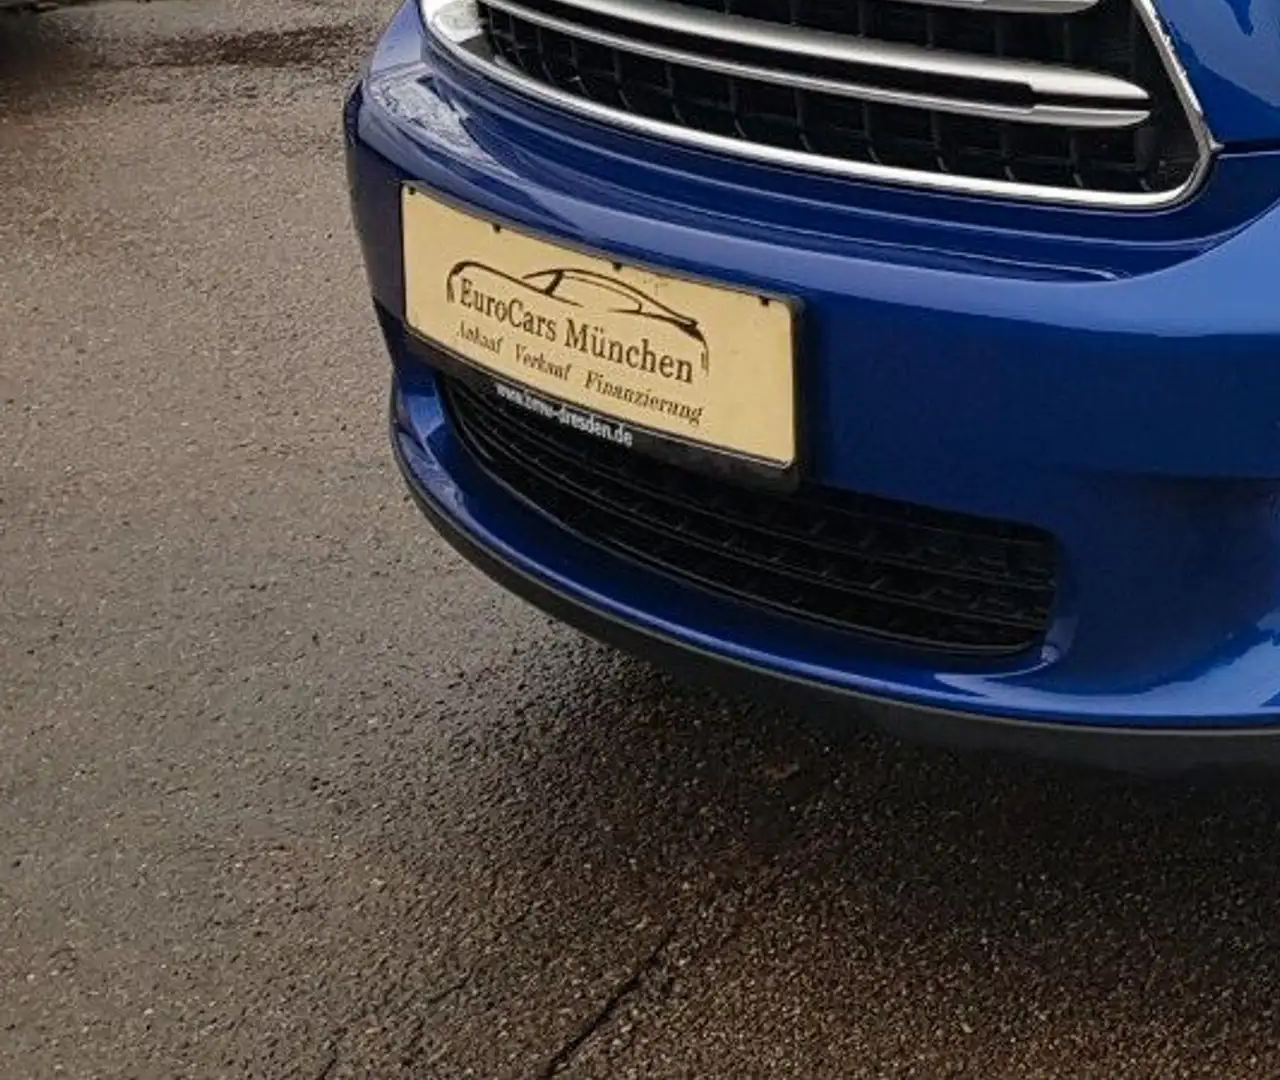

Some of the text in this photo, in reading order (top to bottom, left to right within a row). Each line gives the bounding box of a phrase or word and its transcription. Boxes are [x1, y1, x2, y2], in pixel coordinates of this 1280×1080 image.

[460, 277, 693, 383] EuroCars München
[515, 342, 573, 381] Verkauf
[584, 369, 703, 427] Finanzierung
